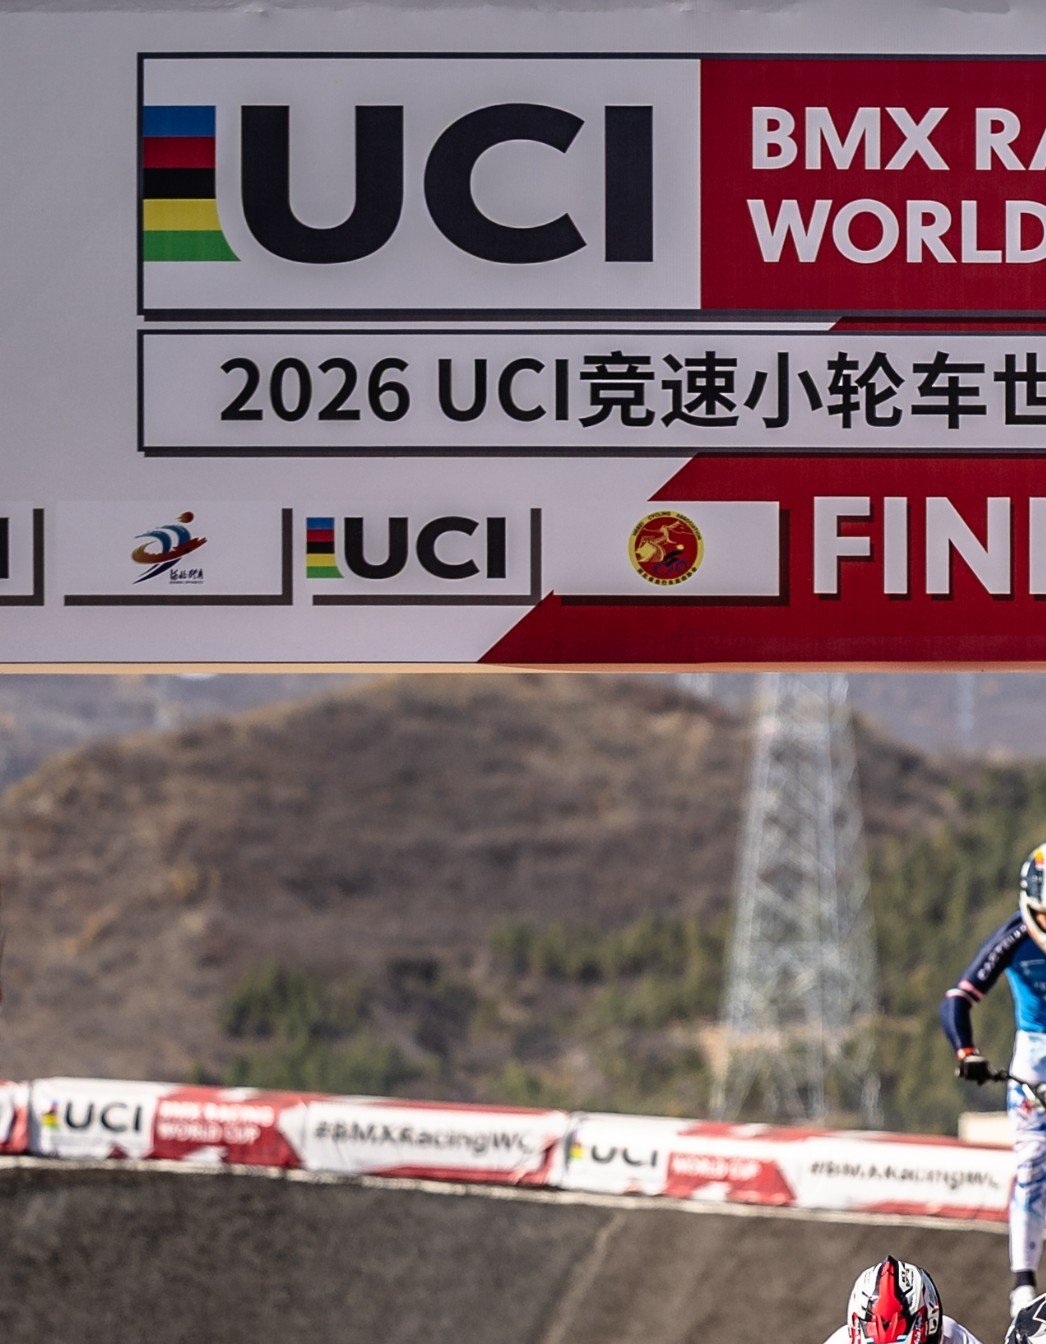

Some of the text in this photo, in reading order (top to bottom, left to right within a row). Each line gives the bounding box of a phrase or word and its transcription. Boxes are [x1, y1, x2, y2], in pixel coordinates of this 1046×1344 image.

[753, 108, 951, 169] BMX
[241, 103, 654, 265] UCI
[221, 357, 412, 422] 2026
[344, 516, 508, 580] UCI
[65, 1101, 143, 1133] UCI
